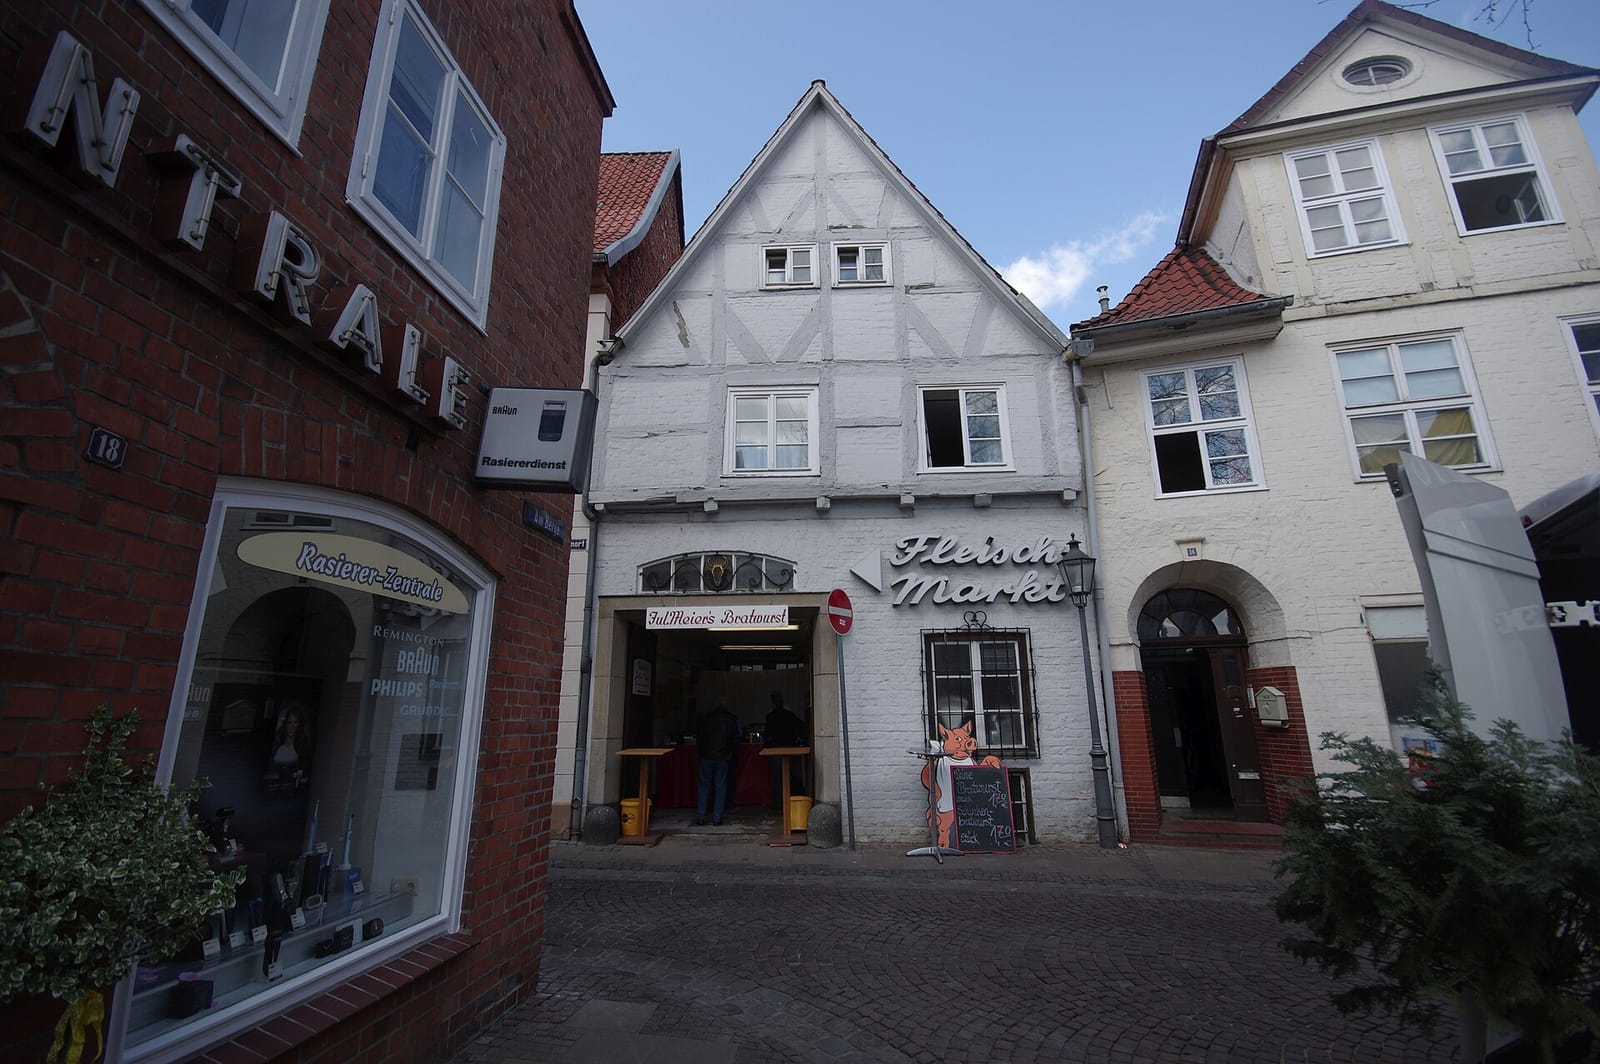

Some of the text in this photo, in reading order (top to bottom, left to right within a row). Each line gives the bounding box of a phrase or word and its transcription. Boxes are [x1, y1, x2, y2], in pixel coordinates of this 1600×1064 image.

[23, 30, 472, 431] NTRALE
[492, 405, 518, 416] BRAUN
[96, 434, 120, 462] 18
[481, 456, 567, 470] Rasiererdienst
[889, 533, 1060, 567] Fleisch
[295, 541, 444, 602] Rasierer-Zentrale
[891, 569, 1066, 607] Markt
[720, 608, 787, 624] Bratwurst
[396, 646, 440, 676] BRAUN
[370, 678, 424, 698] PHILIPS
